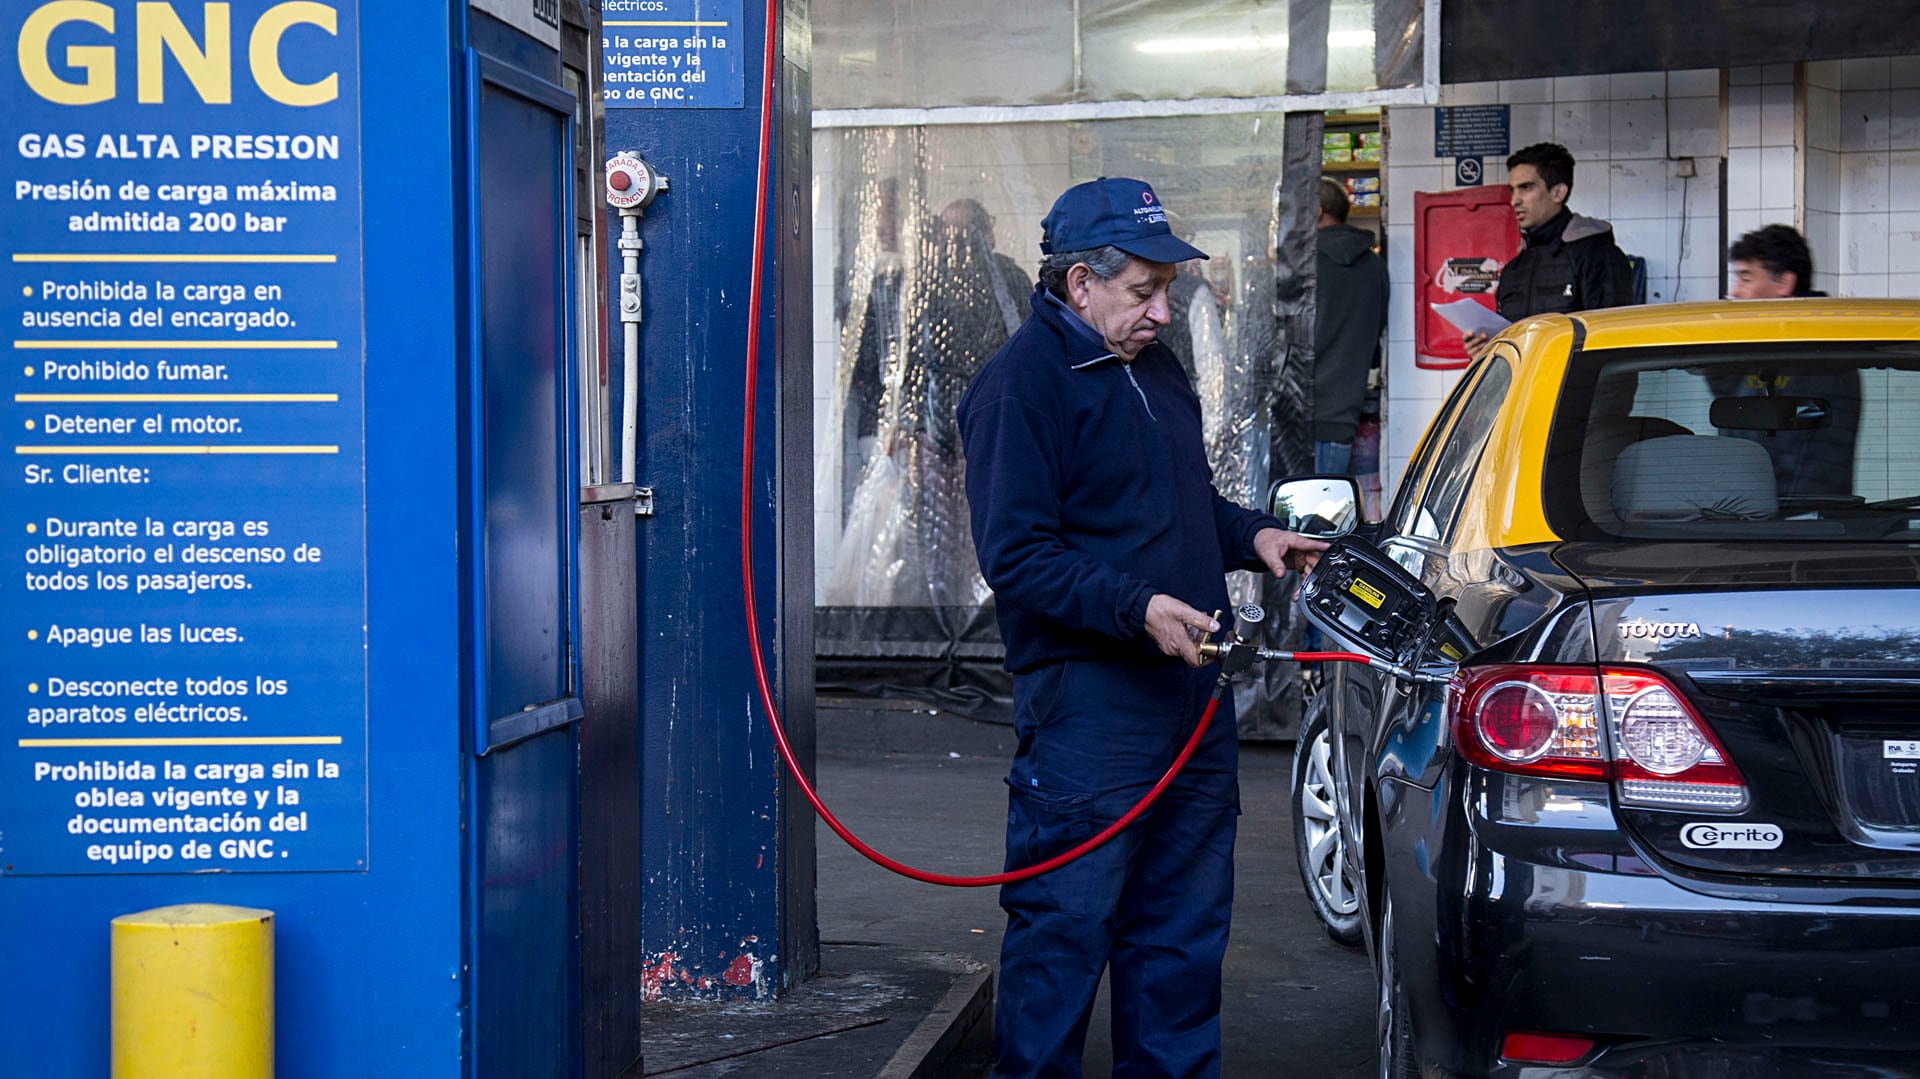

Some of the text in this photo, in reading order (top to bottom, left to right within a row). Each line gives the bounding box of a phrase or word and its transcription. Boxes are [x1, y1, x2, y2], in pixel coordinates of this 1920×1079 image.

[18, 0, 338, 106] GNC
[615, 36, 629, 48] la
[634, 38, 678, 51] carga
[683, 36, 707, 48] sin
[712, 36, 726, 48] la
[607, 53, 701, 68] vigente y la
[603, 69, 706, 82] entación del
[625, 86, 646, 99] de
[649, 87, 685, 100] GNC
[19, 134, 338, 159] GAS ALTA PRESION
[637, 169, 647, 183] DE
[16, 179, 336, 205] Presión de carga máxima
[69, 212, 287, 231] admitida 200 bar
[43, 281, 281, 304] Prohibida la carga en
[23, 308, 295, 331] ausencia del encargado.
[45, 361, 227, 380] Prohibido fumar.
[46, 414, 241, 433] Detener el motor.
[26, 464, 149, 483] Sr. Cliente:
[47, 518, 268, 540] Durante la carga es
[26, 544, 320, 567] obligatorio el descenso de
[26, 571, 251, 593] todos los pasajeros.
[47, 624, 243, 647] Apague las luces.
[1618, 622, 1701, 638] TOYOTA
[49, 676, 287, 696] Desconecte todos los
[28, 702, 247, 726] aparatos eléctricos.
[35, 759, 338, 783] Prohibida la carga sin la
[76, 786, 298, 810] oblea vigente y la
[68, 812, 306, 833] documentación del
[1686, 824, 1779, 846] Cerrito
[87, 841, 173, 864] equipo
[181, 840, 211, 859] de
[220, 840, 273, 858] GNC
